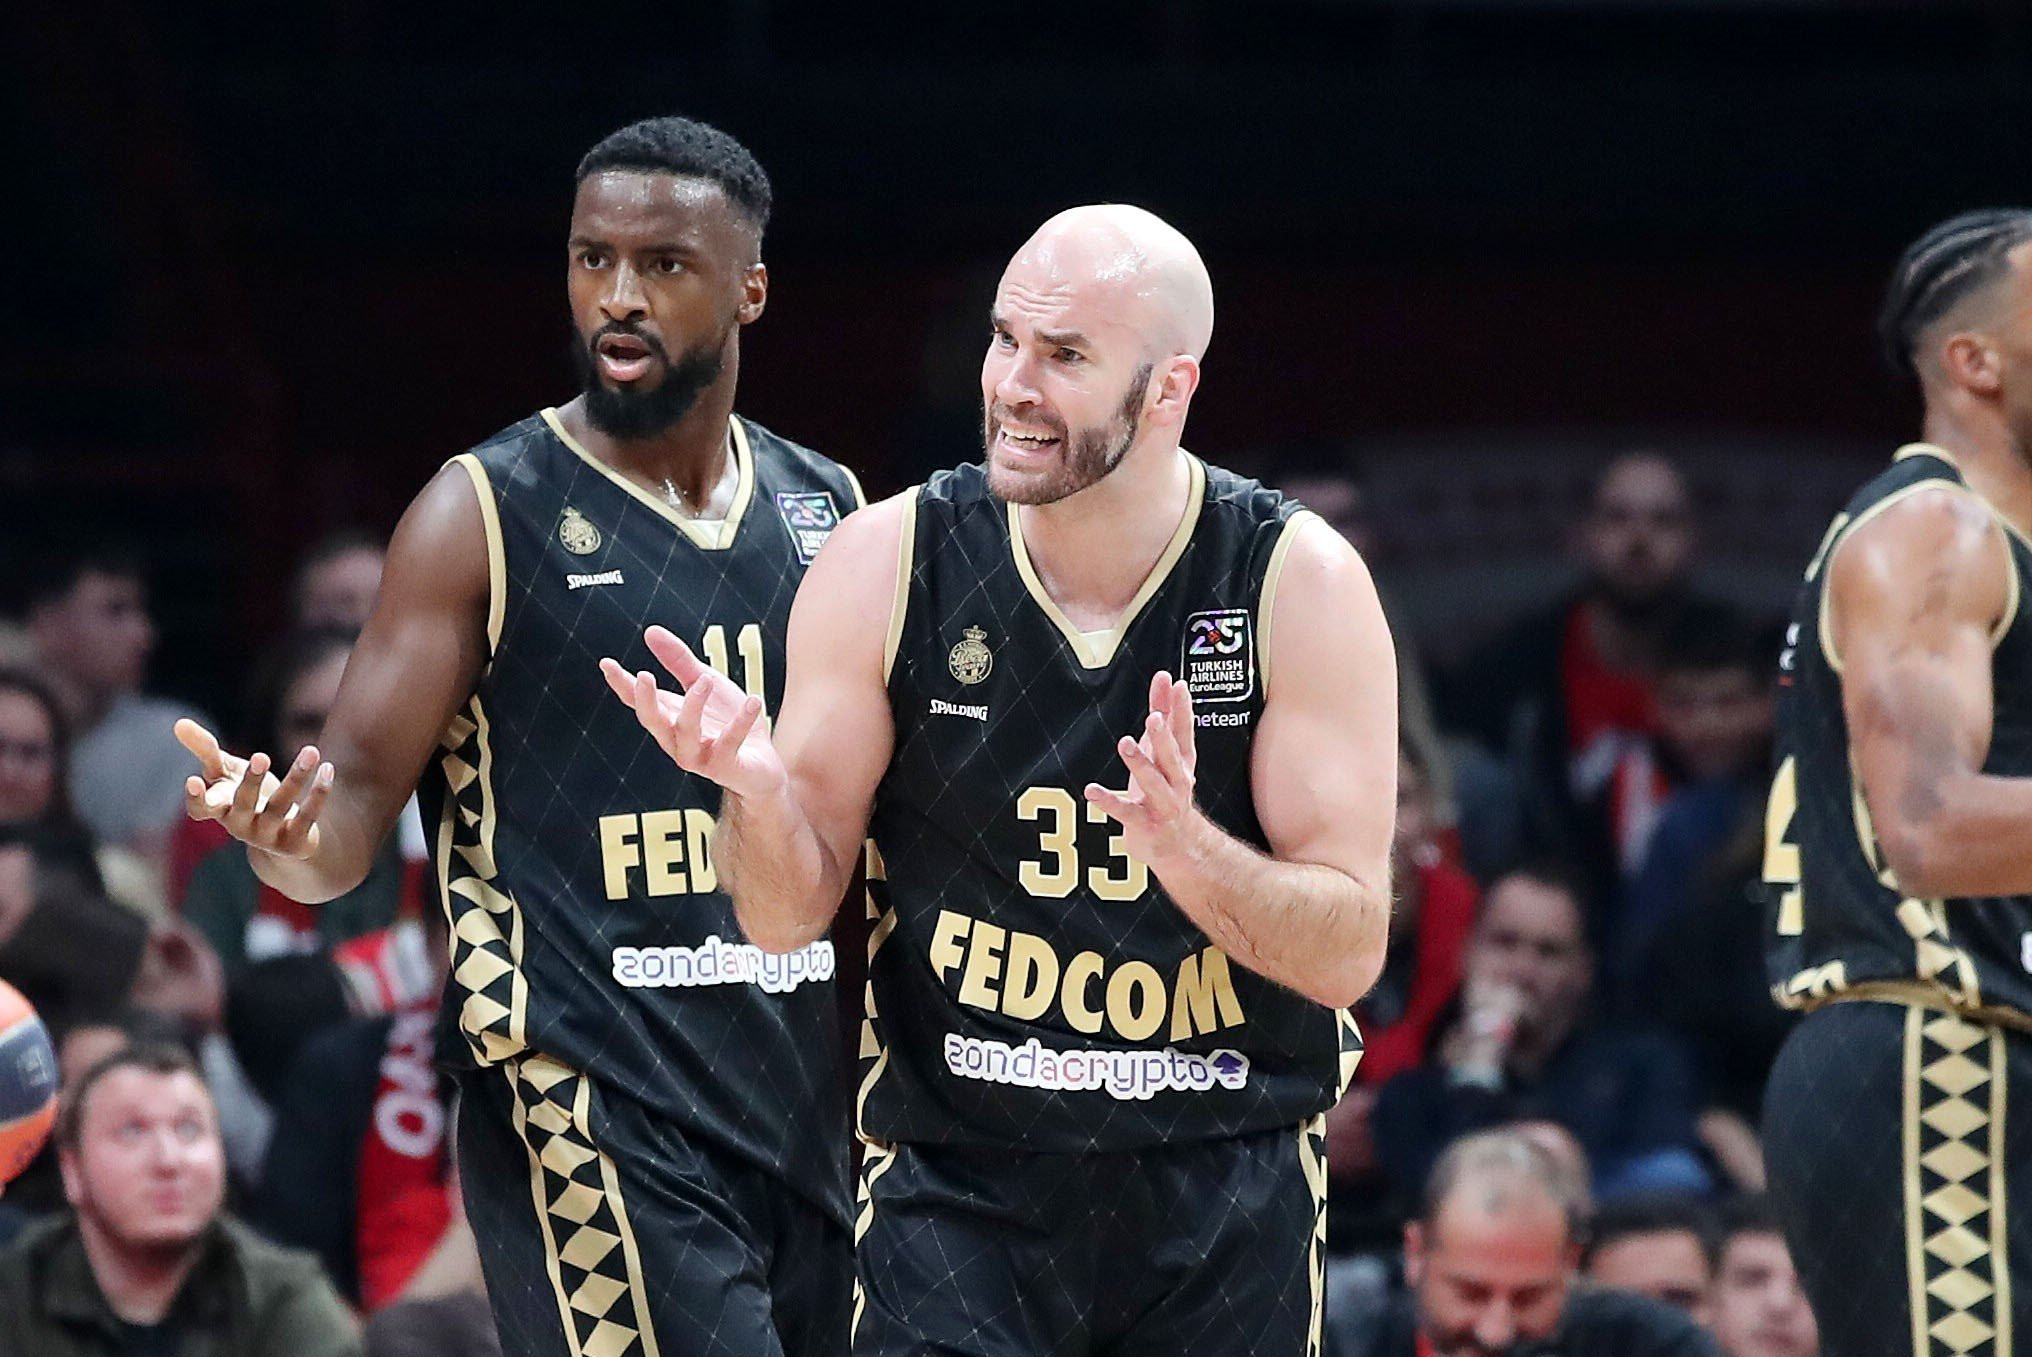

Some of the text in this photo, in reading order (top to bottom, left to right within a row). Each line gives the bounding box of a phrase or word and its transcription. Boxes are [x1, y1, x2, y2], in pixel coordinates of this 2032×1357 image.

[566, 570, 624, 590] SPALDING
[1189, 616, 1244, 654] 25
[1189, 671, 1244, 683] AIRLINES
[1190, 660, 1243, 673] TURKISH
[1189, 682, 1245, 693] EuroLeague
[929, 699, 989, 721] SPALDING
[1194, 711, 1251, 727] neteam
[599, 808, 719, 900] FED
[1017, 786, 1149, 901] 33
[619, 940, 832, 986] zondarypto
[929, 909, 1246, 1042] FEDCOM
[948, 1038, 1209, 1094] zondacrypto
